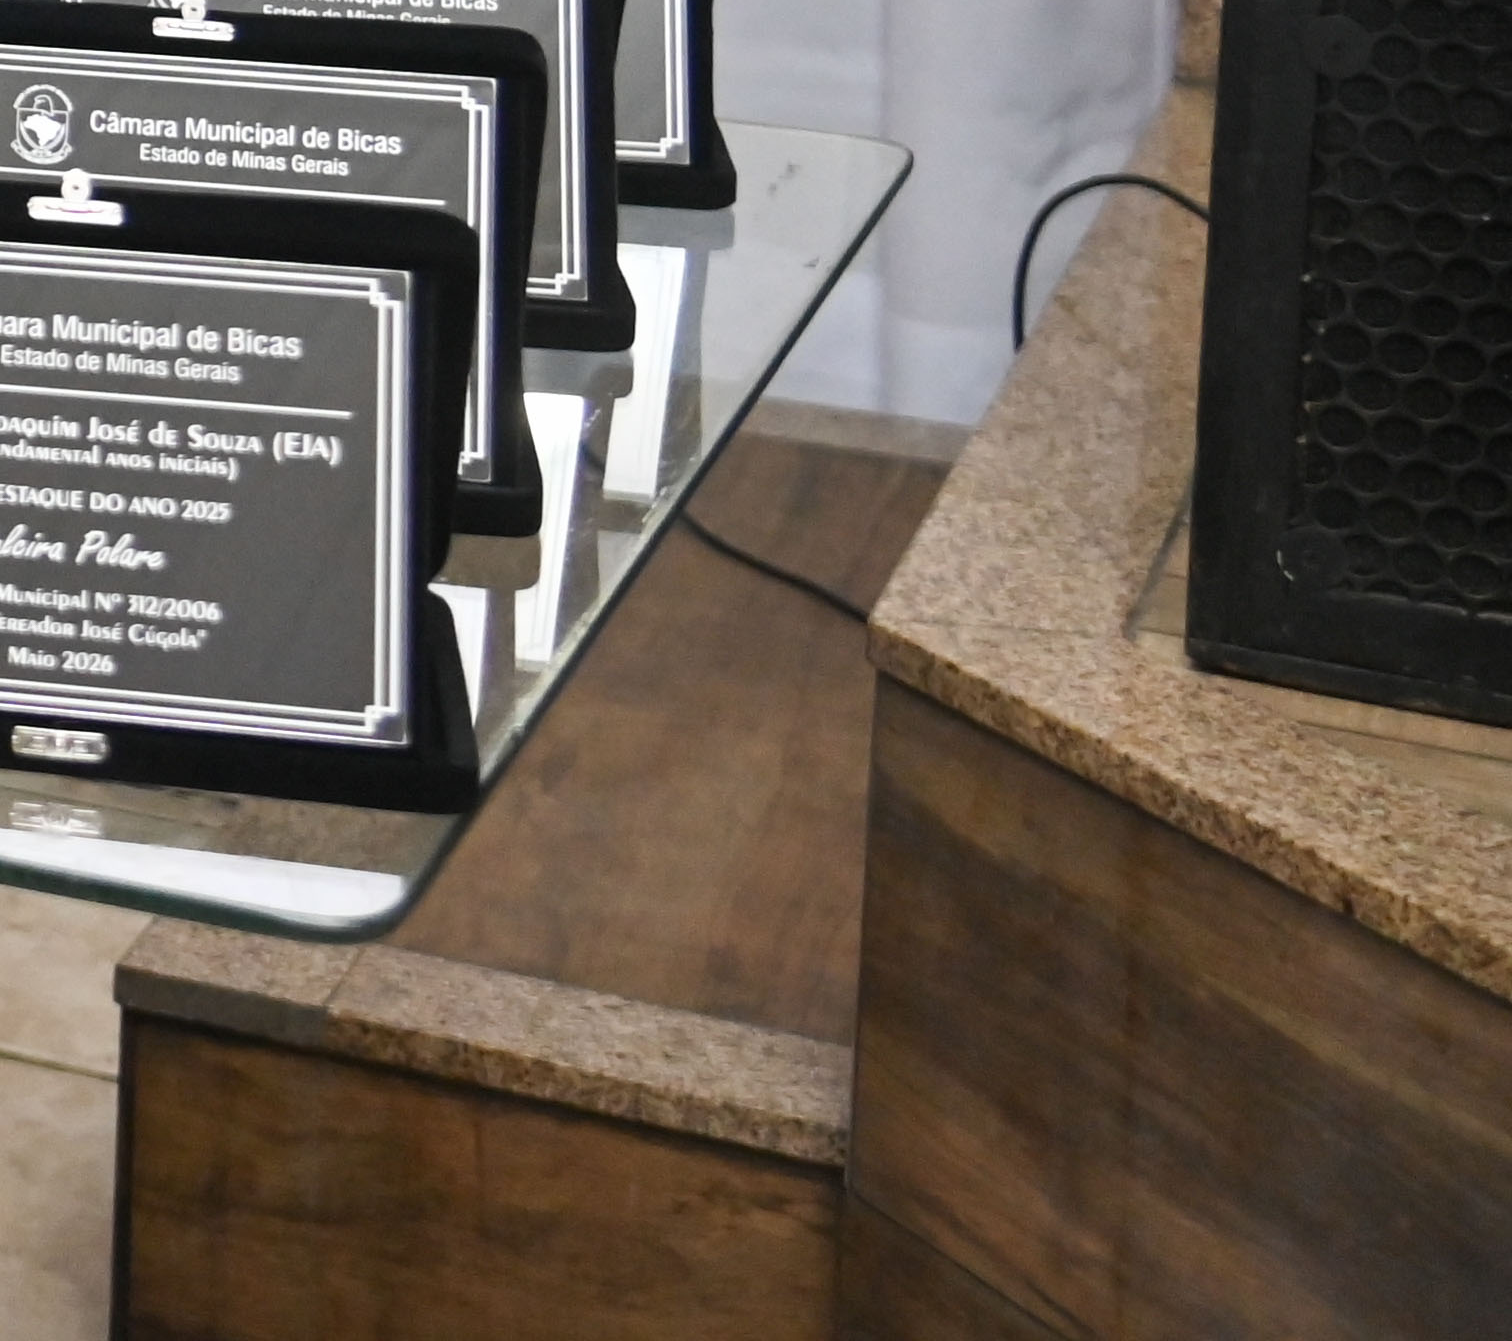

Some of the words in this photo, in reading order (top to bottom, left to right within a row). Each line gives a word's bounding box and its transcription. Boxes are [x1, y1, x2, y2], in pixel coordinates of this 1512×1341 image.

[90, 110, 178, 137] Câmara
[185, 117, 296, 148] Municipal
[302, 126, 331, 149] de
[338, 128, 403, 155] Bicas
[139, 143, 201, 165] Estado
[204, 149, 228, 167] de
[232, 150, 287, 171] Minas
[291, 154, 350, 176] Gerais
[52, 314, 181, 350] Municipal
[186, 325, 222, 351] de
[227, 327, 303, 360] Bicas
[0, 344, 72, 371] Estado
[75, 350, 102, 373] de
[106, 352, 170, 379] Minas
[174, 357, 243, 384] Gerais
[87, 416, 140, 443] José
[148, 420, 179, 446] de
[187, 424, 264, 455] Souza
[272, 432, 343, 467] (EJA)
[159, 453, 240, 482] iniciais)
[89, 491, 127, 514] DO
[128, 496, 178, 518] ANO
[181, 499, 233, 523] 2025
[127, 594, 223, 624] 312/2006
[80, 620, 123, 643] José
[7, 646, 58, 670] Maio
[62, 650, 117, 676] 2026
